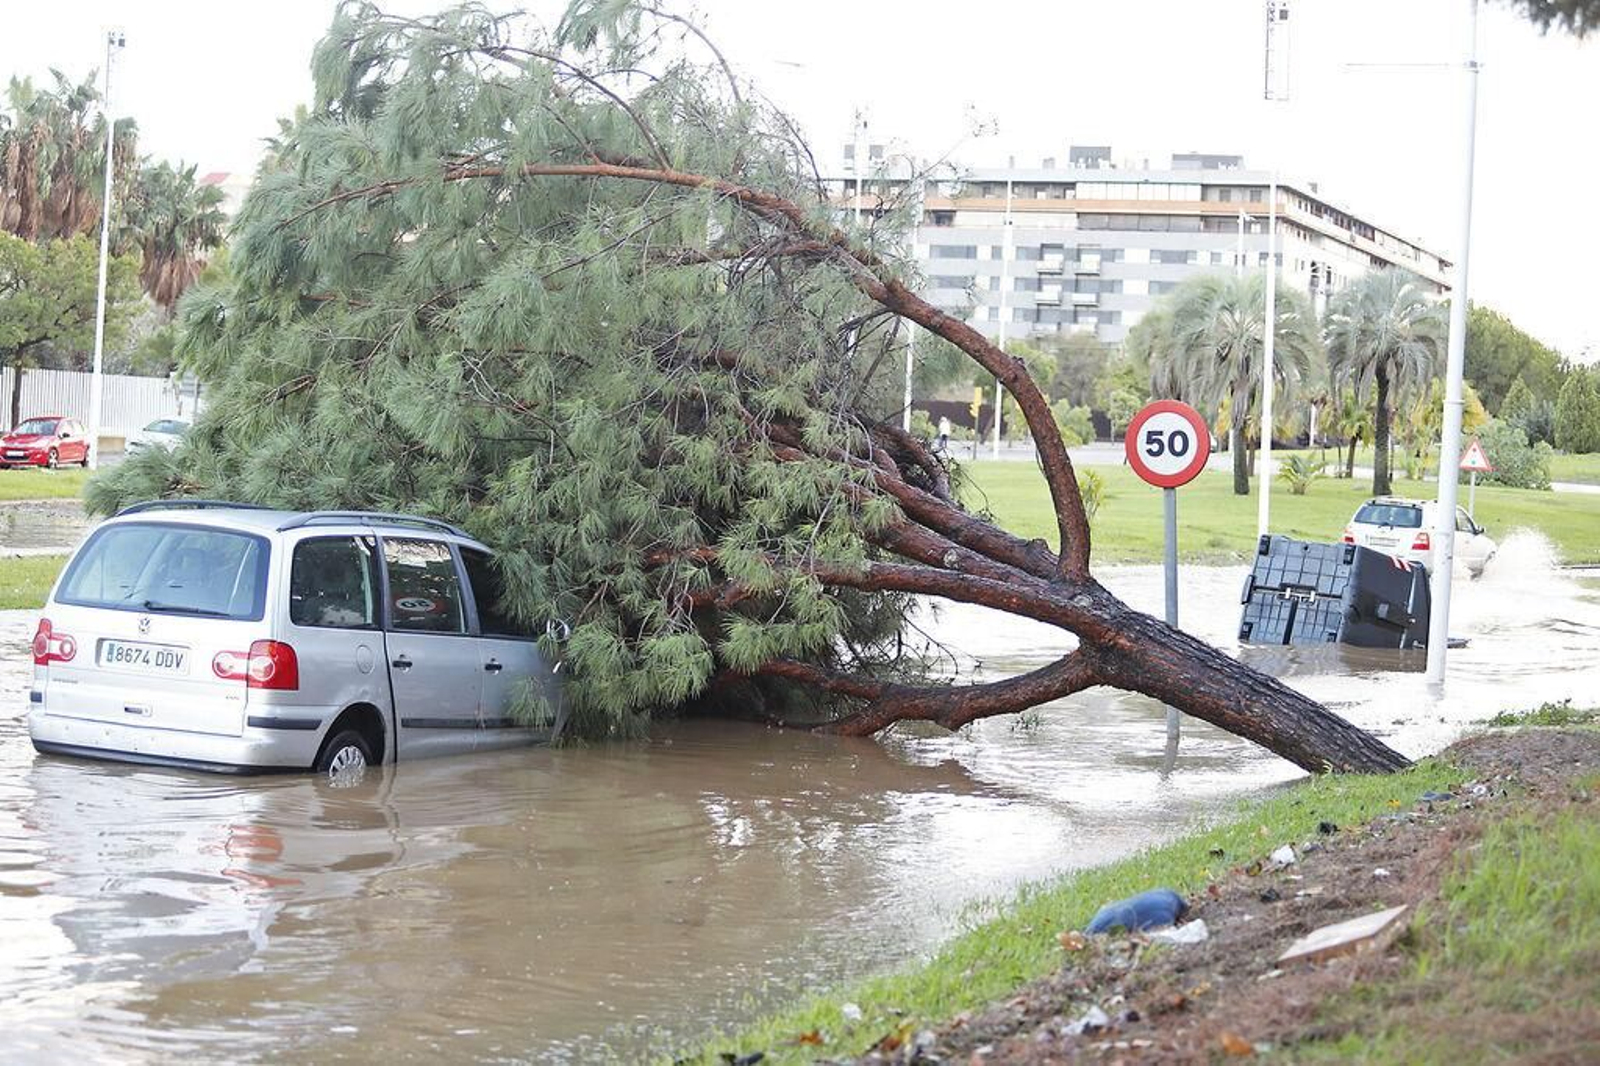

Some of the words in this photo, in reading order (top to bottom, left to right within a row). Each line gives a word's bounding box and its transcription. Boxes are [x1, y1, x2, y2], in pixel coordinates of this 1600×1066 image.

[1145, 430, 1190, 457] 50
[115, 646, 151, 665] 8674
[155, 650, 184, 668] DDV
